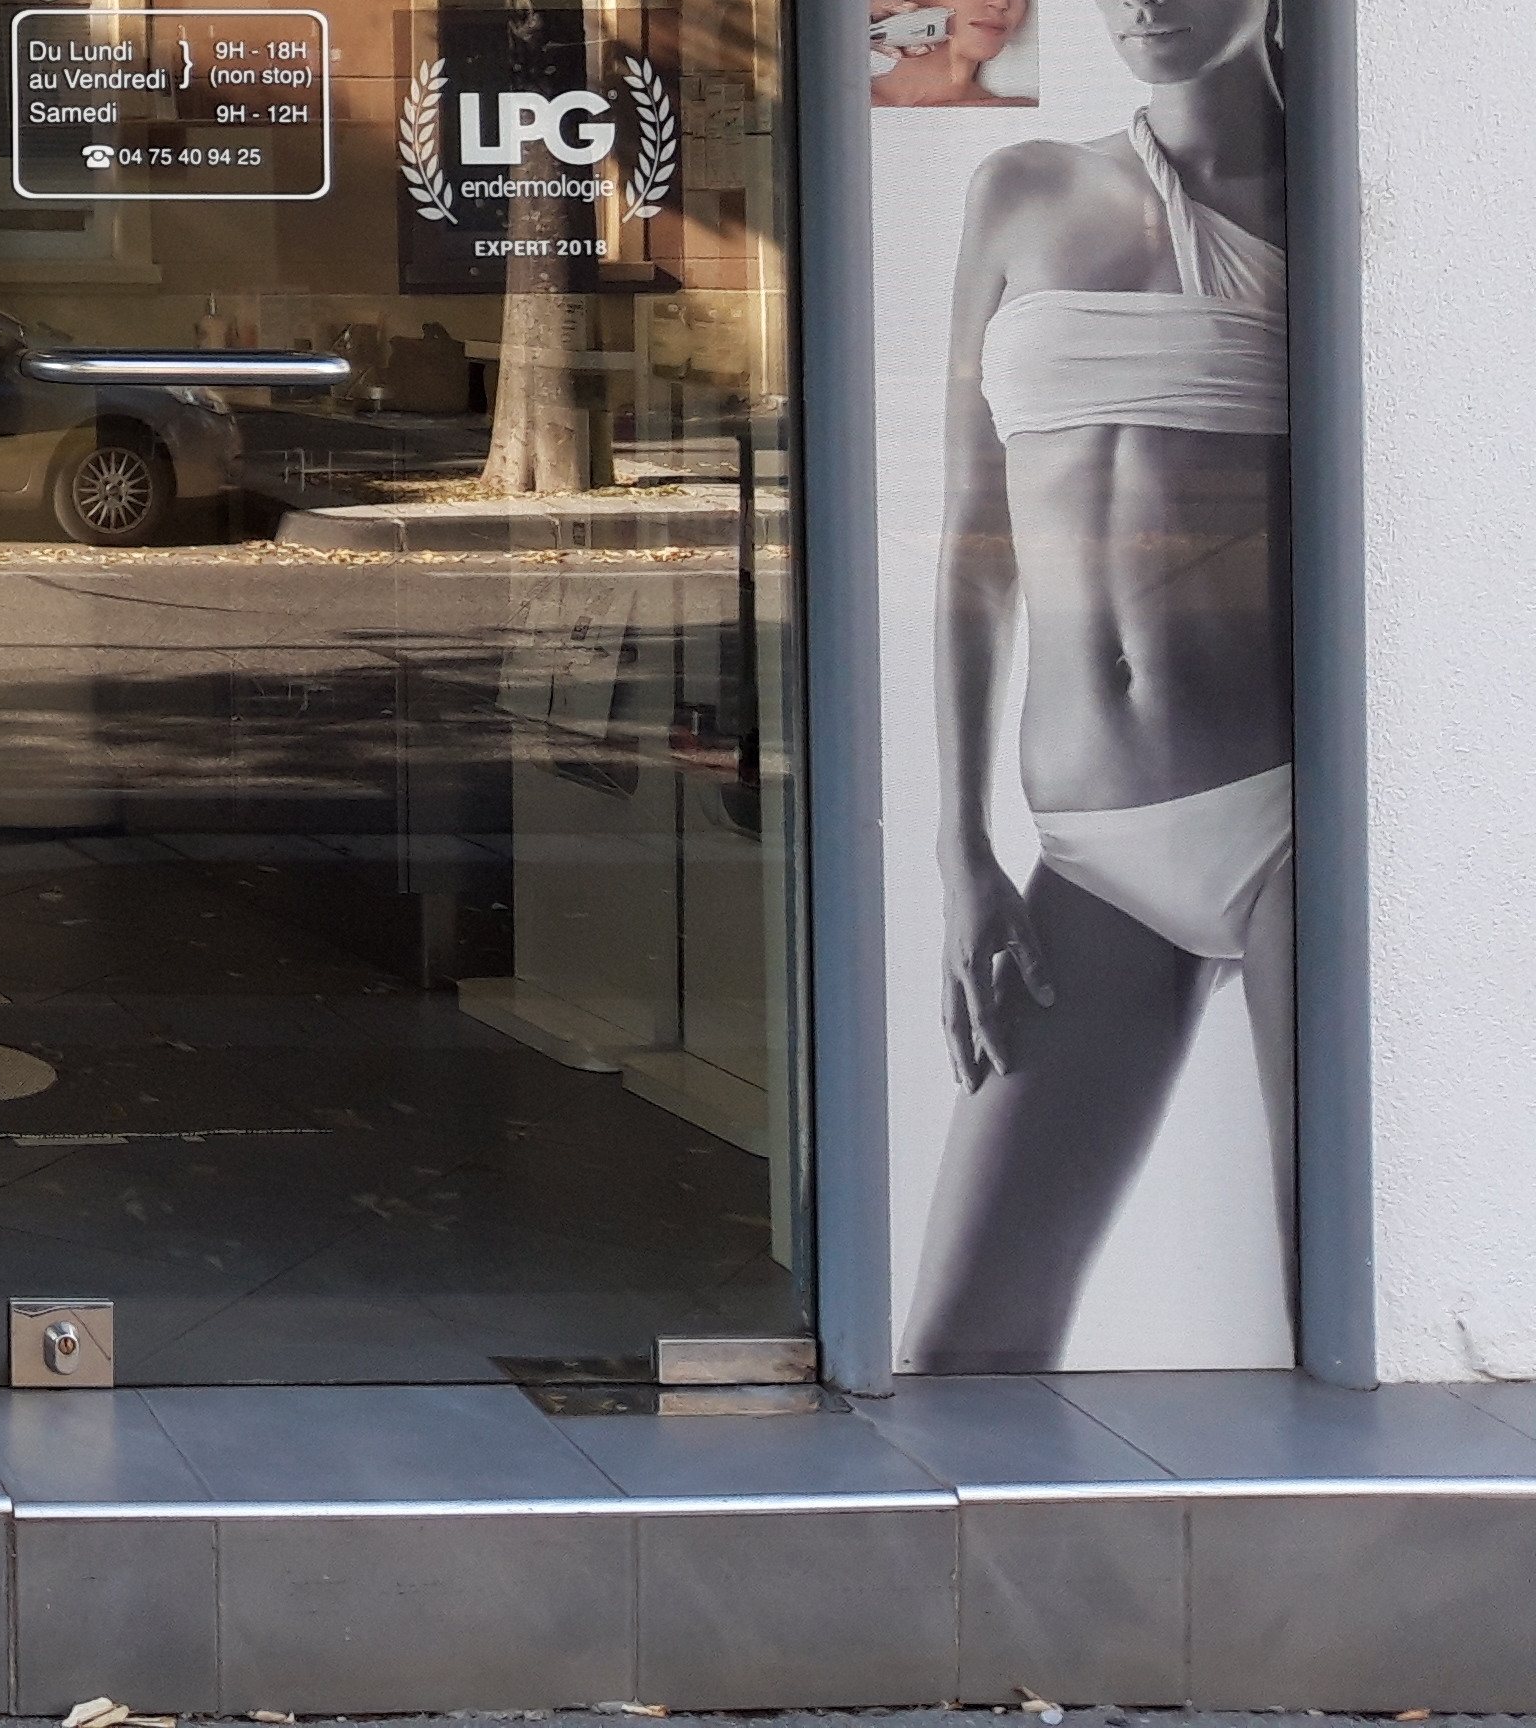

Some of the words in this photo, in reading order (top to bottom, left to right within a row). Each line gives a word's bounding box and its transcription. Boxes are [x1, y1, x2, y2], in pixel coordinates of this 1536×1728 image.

[29, 41, 61, 61] Du
[70, 41, 133, 61] Lundi
[214, 41, 244, 59] 9H
[267, 41, 307, 59] 18H
[29, 73, 57, 90] au
[64, 69, 166, 90] Vendredi
[210, 66, 255, 88] (non
[262, 65, 312, 89] stop)
[29, 101, 117, 124] Samedi
[216, 105, 245, 123] 9H
[268, 105, 308, 123] 12H
[460, 90, 615, 165] LPG
[119, 149, 142, 166] 04
[149, 149, 172, 166] 75
[178, 149, 202, 166] 40
[208, 149, 231, 166] 94
[237, 149, 261, 166] 25
[461, 174, 614, 202] endermologie
[475, 240, 550, 256] EXPERT
[557, 240, 607, 255] 2018
